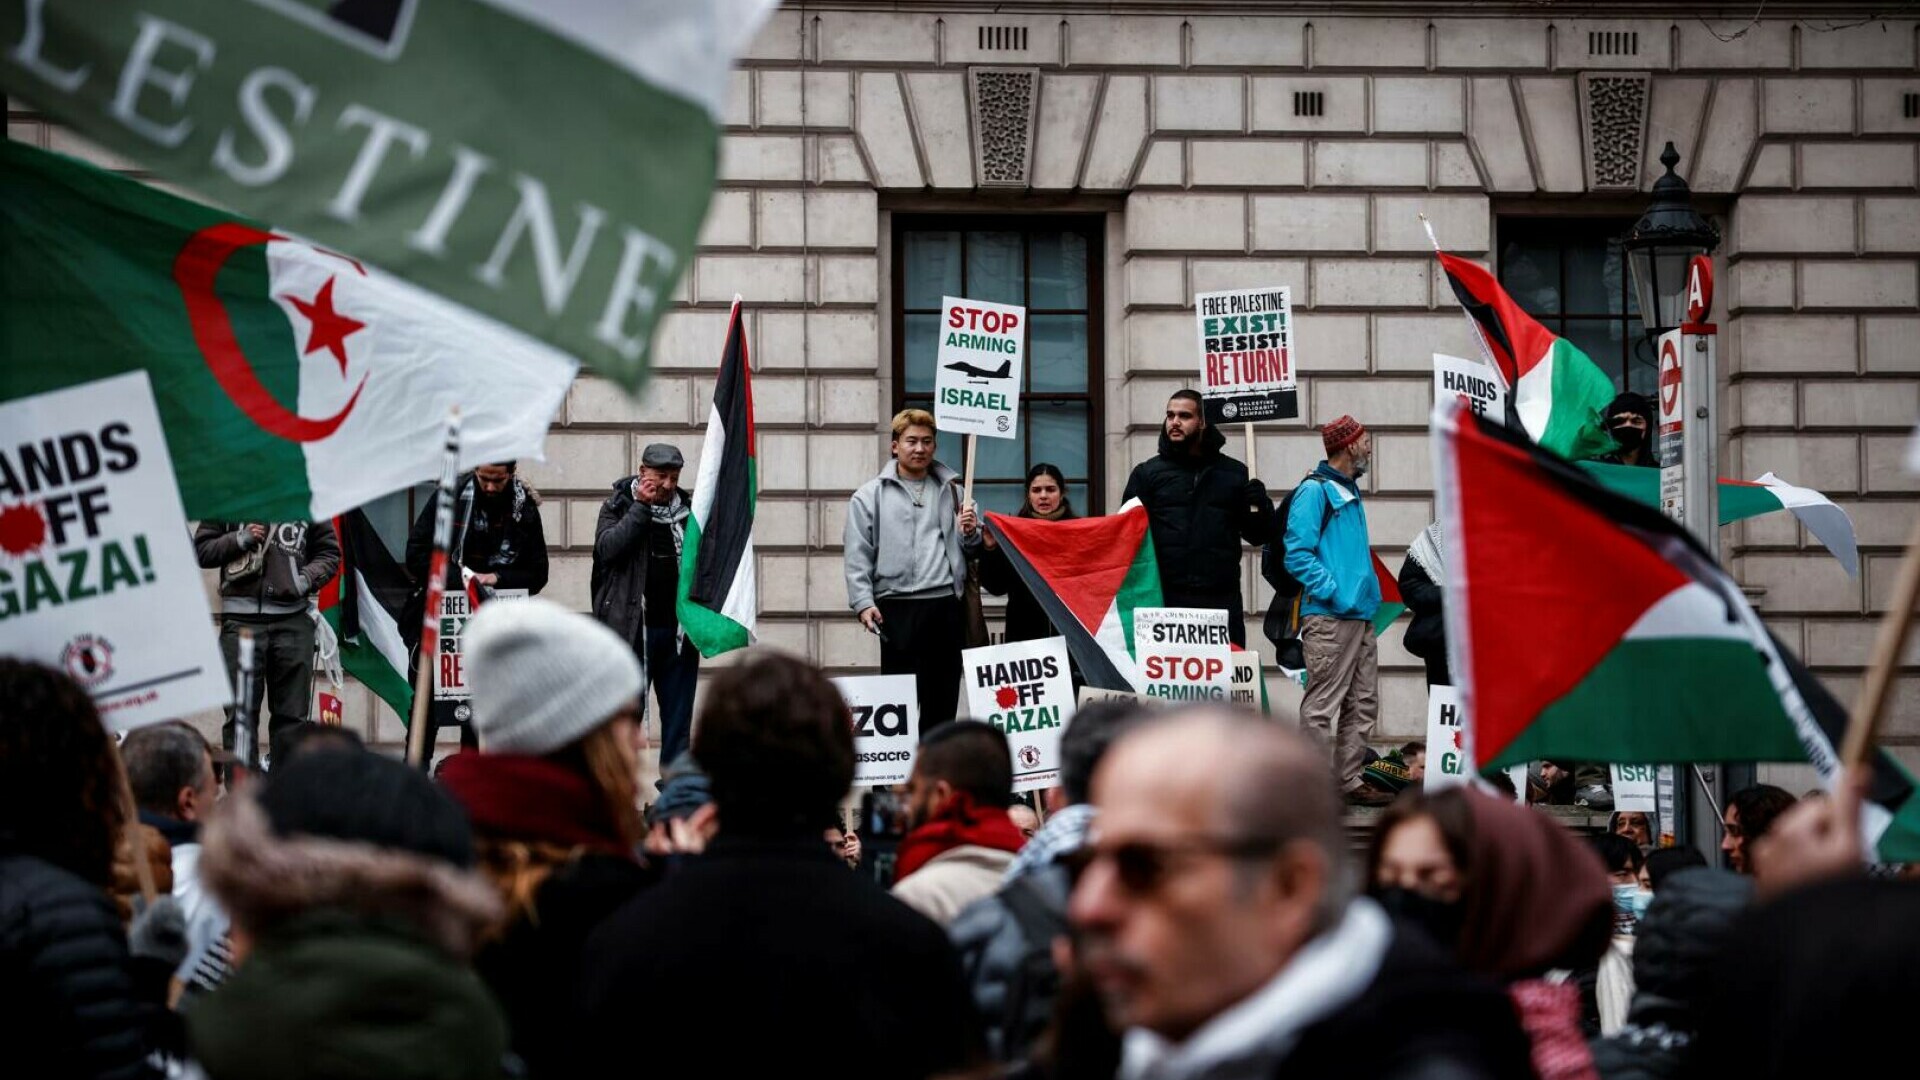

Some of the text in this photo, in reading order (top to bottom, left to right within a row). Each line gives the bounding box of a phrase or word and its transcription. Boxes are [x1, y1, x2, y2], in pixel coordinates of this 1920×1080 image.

[1688, 263, 1704, 310] A
[1202, 292, 1284, 316] FREE PALESTINE
[948, 306, 1019, 334] STOP
[1203, 312, 1286, 337] EXIST!
[945, 332, 1016, 354] ARMING
[1204, 332, 1287, 353] RESIST!
[1205, 348, 1288, 387] RETURN!
[1442, 370, 1497, 401] HANDS
[940, 387, 1012, 411] ISRAEL
[1153, 623, 1230, 645] STARMER
[976, 656, 1059, 688] HANDS
[1146, 655, 1224, 681] STOP
[1146, 684, 1224, 702] ARMING
[988, 705, 1061, 735] GAZA!
[854, 750, 911, 763] assacre
